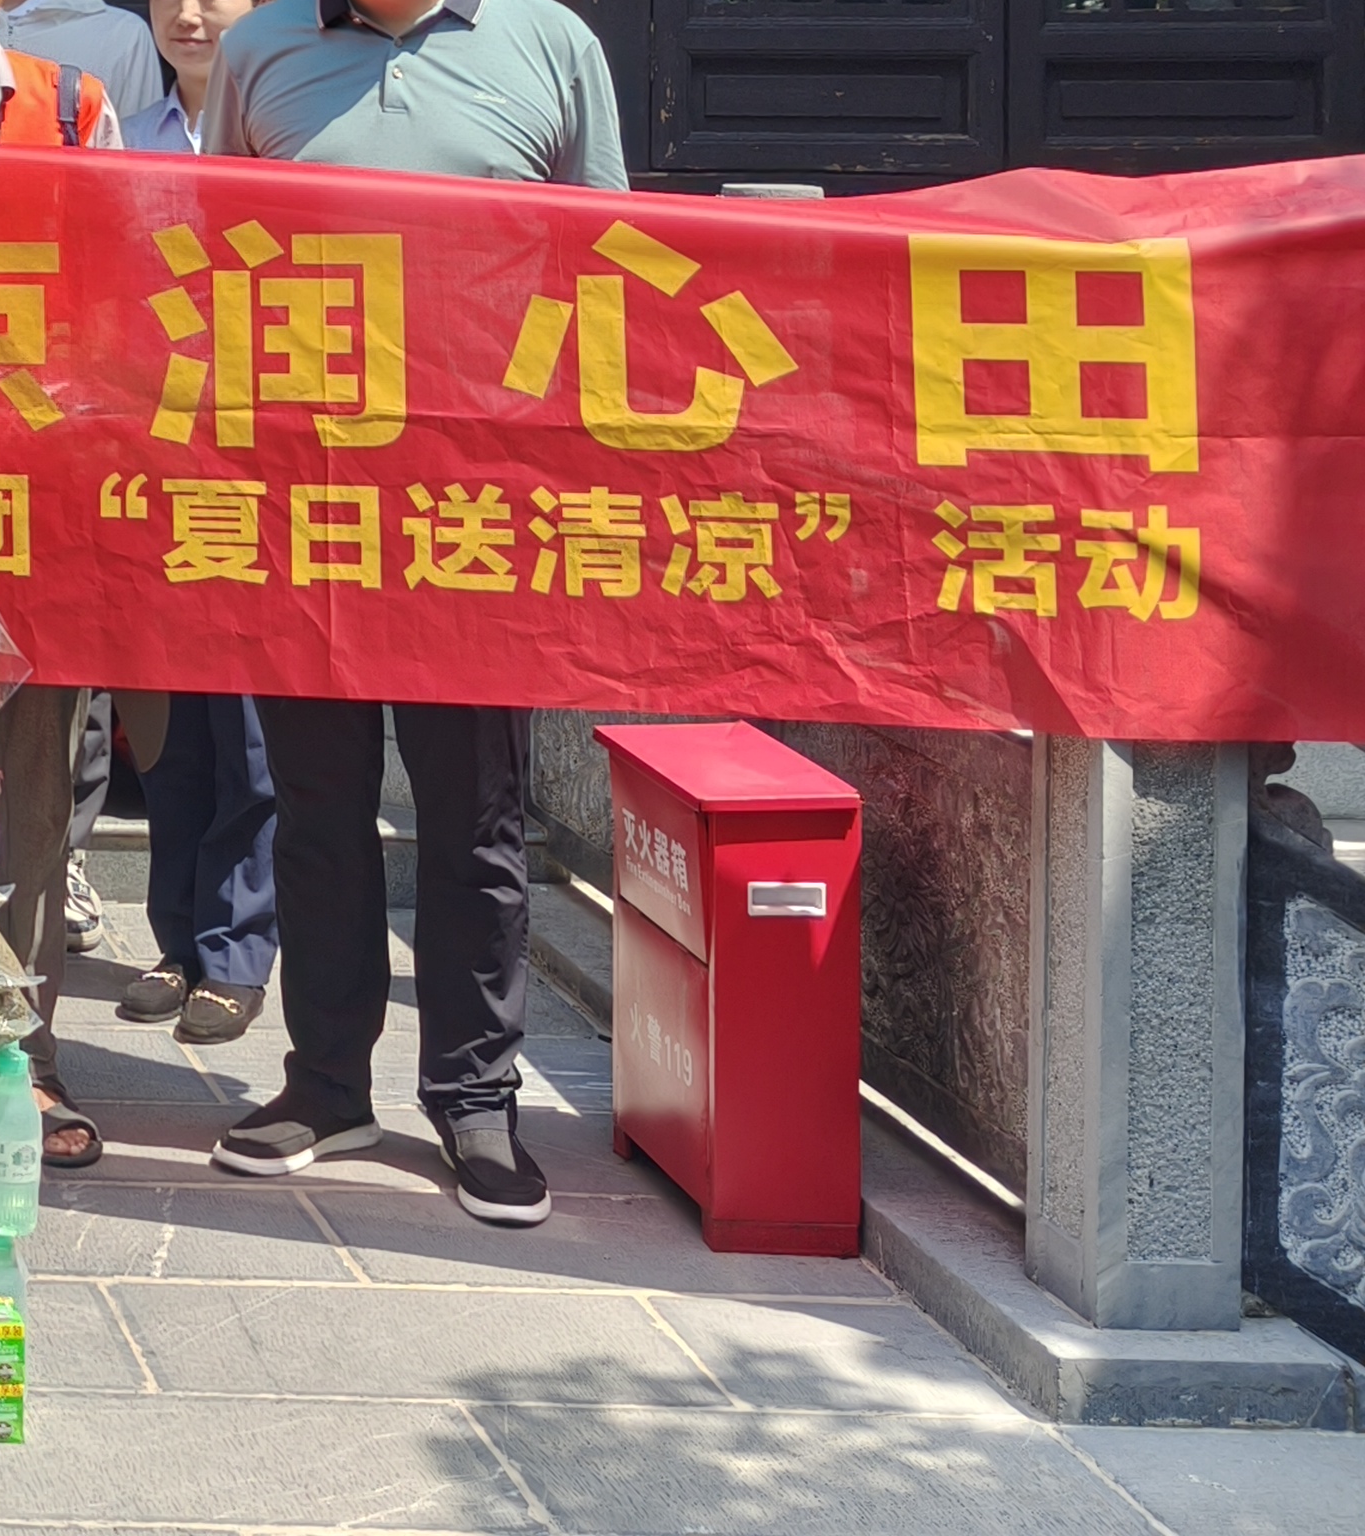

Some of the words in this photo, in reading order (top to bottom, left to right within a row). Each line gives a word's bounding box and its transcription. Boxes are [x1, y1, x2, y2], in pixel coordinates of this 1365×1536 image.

[622, 807, 689, 893] 灭火器箱
[678, 893, 692, 916] Box
[630, 1002, 694, 1087] 火警119
